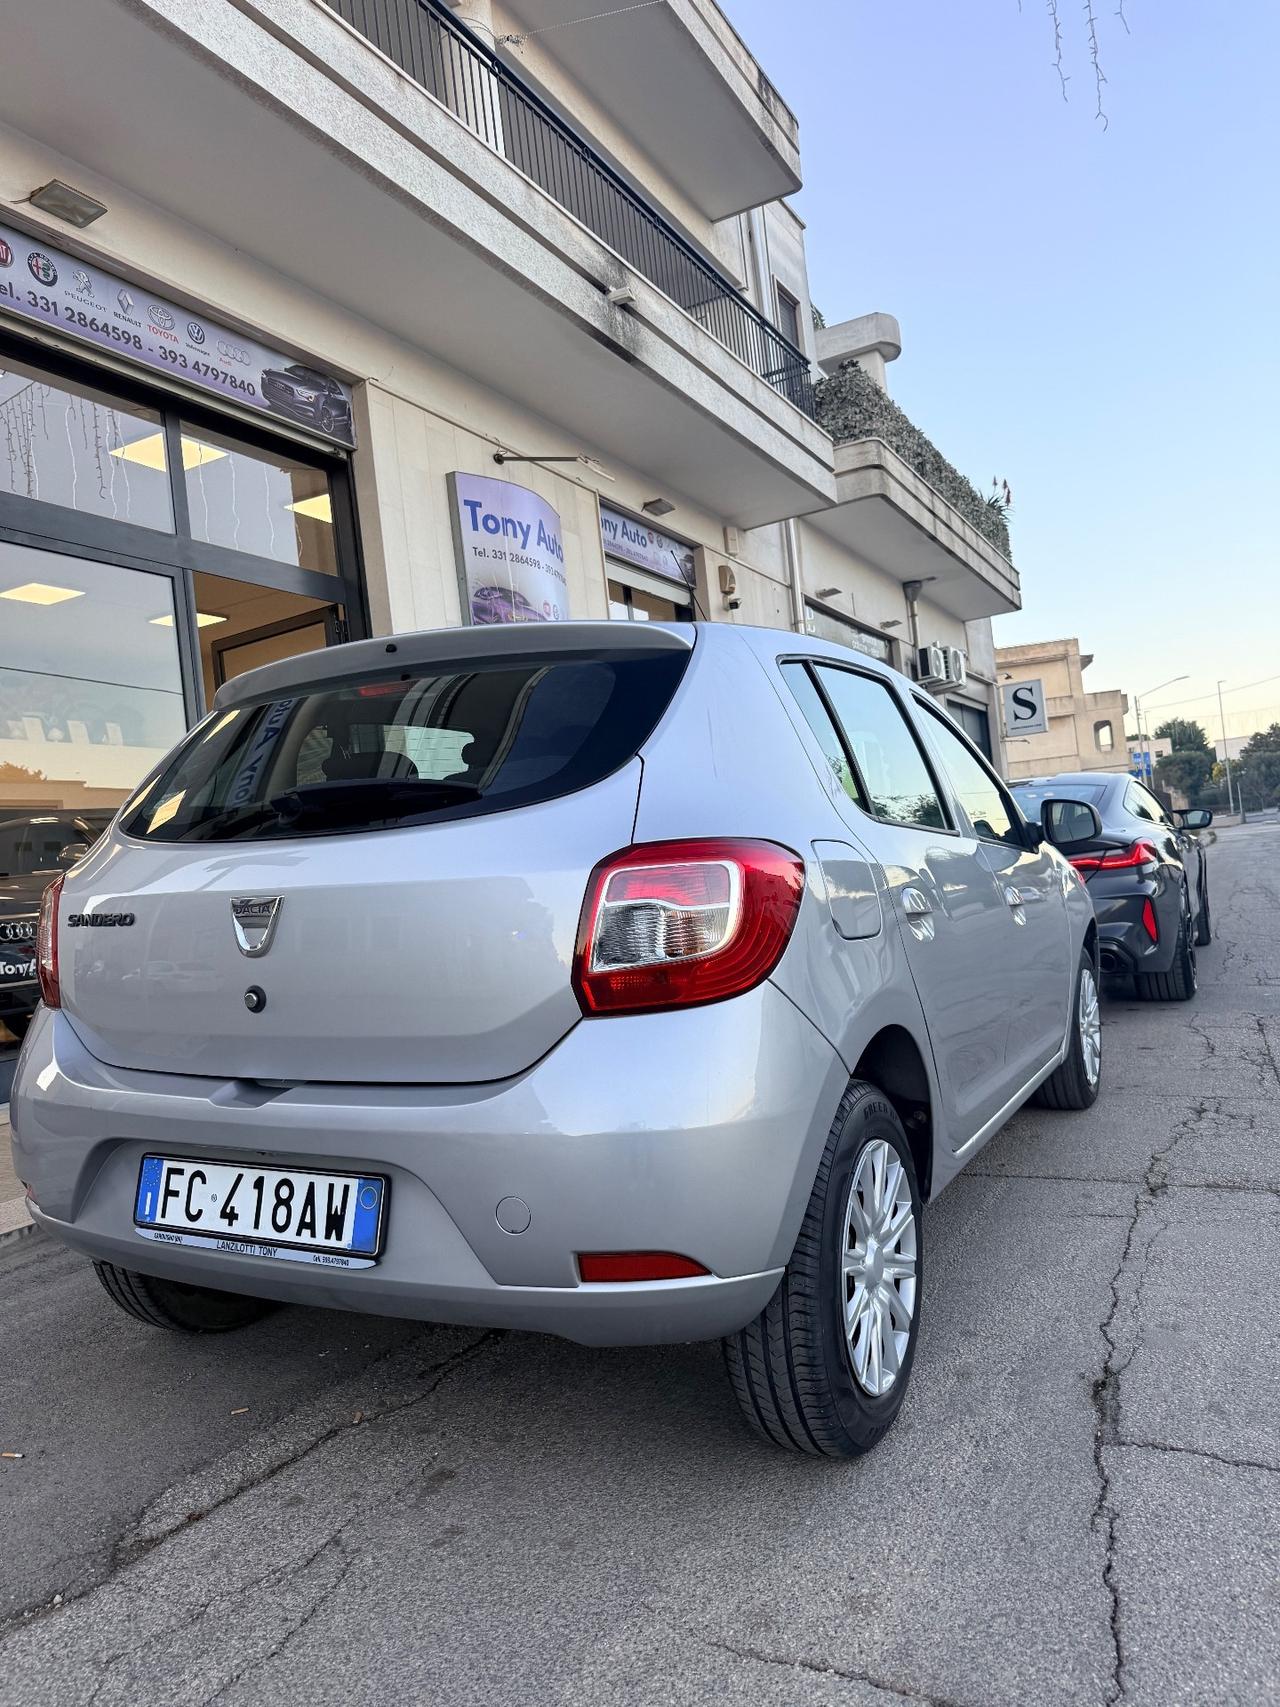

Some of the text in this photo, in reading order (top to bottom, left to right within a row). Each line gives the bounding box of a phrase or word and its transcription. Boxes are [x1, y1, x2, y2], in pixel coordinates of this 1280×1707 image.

[64, 290, 108, 313] PEUGEOT
[113, 311, 142, 328] RENAULT
[0, 281, 21, 301] el.
[27, 290, 59, 317] 331
[64, 306, 143, 350] 2864598
[159, 345, 188, 369] 393
[192, 360, 256, 397] 4797840
[147, 324, 180, 345] TOYOTA
[463, 499, 531, 550] Tony
[536, 518, 564, 563] Auto
[621, 520, 647, 548] Auto
[472, 546, 490, 559] Tel.
[492, 548, 507, 561] 331
[509, 551, 541, 571] 2864598
[1012, 686, 1037, 722] S
[68, 912, 135, 928] SANDERO
[234, 904, 271, 915] DACIA
[216, 1240, 278, 1257] LANZILOTTI TONY
